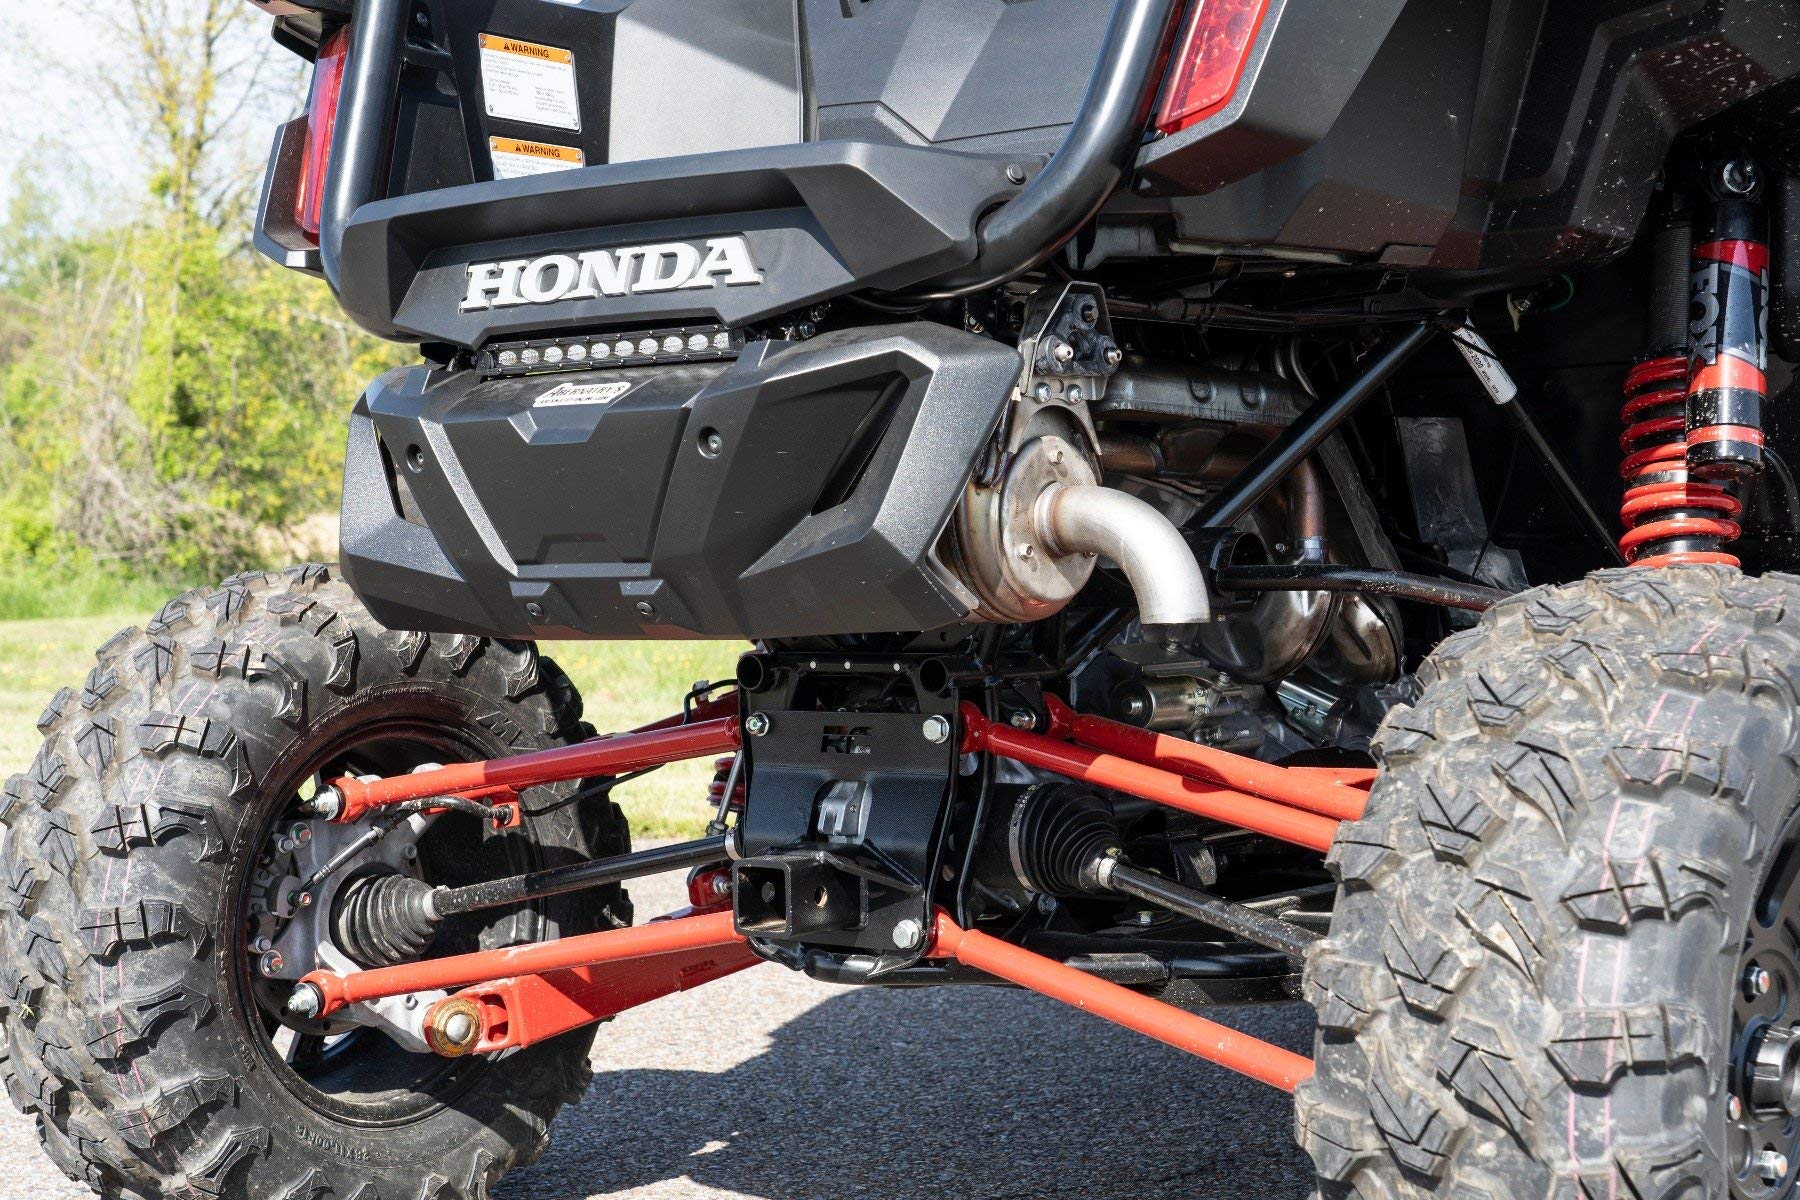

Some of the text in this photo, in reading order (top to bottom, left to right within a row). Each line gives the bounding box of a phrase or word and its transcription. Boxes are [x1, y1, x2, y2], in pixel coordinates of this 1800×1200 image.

[510, 42, 550, 58] WARNING
[522, 146, 561, 158] WARNING
[458, 236, 764, 314] HONDA
[1688, 263, 1720, 366] FOX
[1471, 354, 1484, 369] 2020
